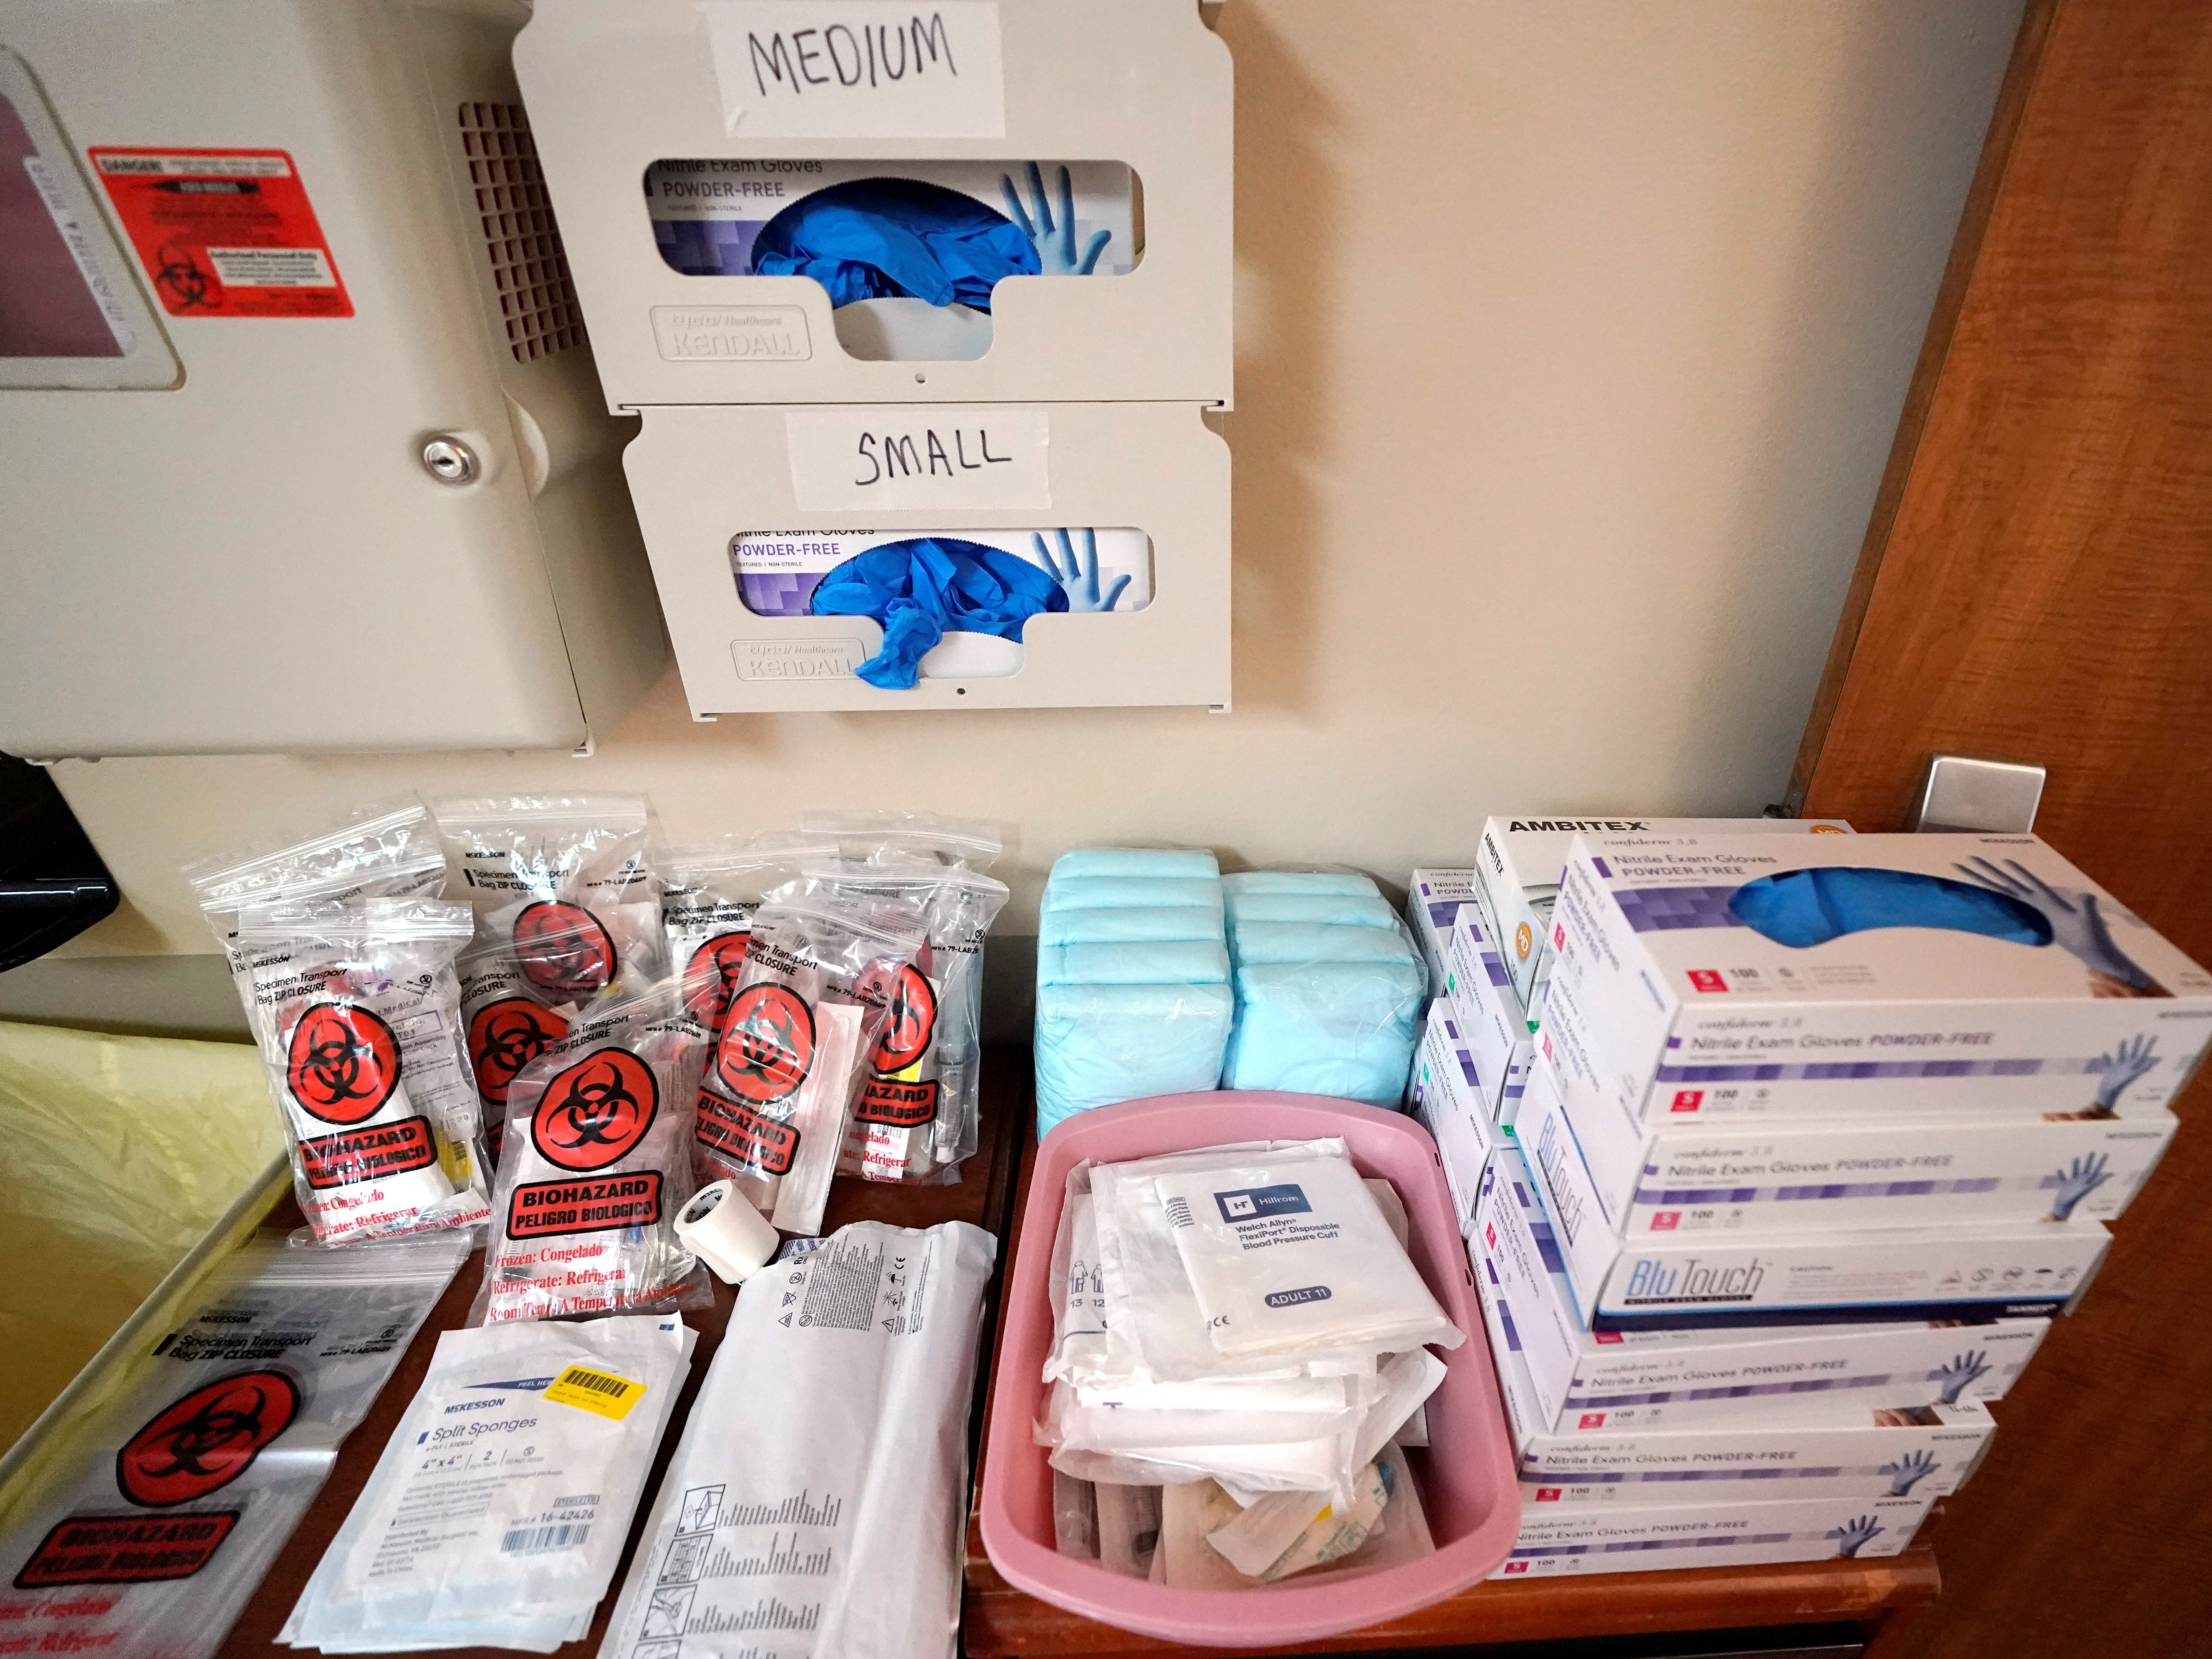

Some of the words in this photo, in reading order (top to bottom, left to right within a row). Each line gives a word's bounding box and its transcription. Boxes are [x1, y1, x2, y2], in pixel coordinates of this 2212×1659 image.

[749, 13, 957, 97] MEDIUM
[662, 182, 785, 197] POWDER-FREE
[856, 429, 1013, 486] SMALL
[732, 543, 841, 556] POWDER-FREE
[1614, 855, 1663, 864] Nitrile
[1667, 855, 1712, 864] Exam
[1716, 854, 1777, 864] Gloves
[473, 869, 518, 879] Specimen
[1622, 866, 1746, 877] POWDER-FREE
[478, 879, 496, 890] Bag
[496, 881, 509, 889] ZIP
[713, 902, 760, 912] Transport
[669, 916, 687, 927] Bag
[707, 912, 745, 923] CLOSURE
[1518, 929, 1529, 952] MD
[754, 952, 798, 976] CLOSURE
[772, 943, 818, 970] Transport
[255, 976, 297, 992] Specimen
[300, 968, 348, 983] Transport
[1453, 948, 1475, 1007] POWDER-FREE
[1456, 936, 1465, 963] Nitrile
[1465, 958, 1473, 982] Exam
[1472, 981, 1484, 1015] Gloves
[257, 995, 273, 1005] Bag
[274, 991, 287, 1001] ZIP
[288, 981, 327, 998] CLOSURE
[842, 988, 886, 1009] 79-LAB20609
[581, 1015, 629, 1032] Transport
[554, 1043, 569, 1055] ZIP
[570, 1028, 612, 1049] CLOSURE
[1691, 1036, 1742, 1050] Nitrile
[1745, 1035, 1794, 1049] Exam
[1800, 1034, 1862, 1049] Gloves
[1869, 1032, 1995, 1047] POWDER-FREE
[1426, 1040, 1449, 1101] POWDER-FREE
[1429, 1028, 1438, 1054] Nitrile
[1437, 1052, 1447, 1078] Exam
[1445, 1077, 1459, 1112] Gloves
[699, 1095, 787, 1146] BIOHAZARD
[870, 1104, 931, 1119] BIOLOGICO
[302, 1126, 417, 1163] BIOHAZARD
[863, 1150, 912, 1168] Refrigerar
[1721, 1163, 1766, 1177] Exam
[1770, 1161, 1830, 1175] Gloves
[1836, 1154, 1954, 1170] POWDER-FREE
[523, 1179, 649, 1208] BIOHAZARD
[1259, 1194, 1299, 1206] Hillrom
[356, 1206, 417, 1229] Refrigerar
[441, 1207, 491, 1227] Ambiente
[515, 1209, 577, 1230] PELIGRO
[581, 1200, 652, 1222] BIOLOGICO
[1235, 1222, 1267, 1233] Welch
[1289, 1222, 1340, 1234] Disposable
[1242, 1239, 1272, 1250] Blood
[1273, 1233, 1316, 1245] Pressure
[1316, 1230, 1339, 1239] Cuff
[1494, 1198, 1526, 1281] POWDER-FREE
[1496, 1186, 1510, 1220] Nitrile
[1509, 1219, 1523, 1254] Exam
[1522, 1252, 1539, 1299] Gloves
[494, 1253, 536, 1268] Frozen:
[540, 1243, 603, 1264] Congelado
[493, 1275, 562, 1295] Refrigerate:
[566, 1267, 628, 1287] Refrigerar
[1070, 1298, 1083, 1308] 13
[1092, 1298, 1105, 1308] 12
[1270, 1290, 1311, 1306] ADULT
[1316, 1288, 1327, 1298] 11
[490, 1305, 521, 1322] Room
[561, 1299, 570, 1313] A
[179, 1334, 253, 1348] Specimen
[250, 1336, 311, 1347] Transport
[168, 1348, 200, 1361] Bag
[200, 1349, 225, 1360] ZIP
[223, 1348, 285, 1360] CLOSURE
[1591, 1377, 1634, 1388] Nitrile
[1639, 1374, 1679, 1385] Exam
[1682, 1369, 1737, 1382] Gloves
[1742, 1359, 1849, 1376] POWDER-FREE
[432, 1423, 466, 1442] Split
[468, 1417, 538, 1437] Sponges
[483, 1450, 492, 1461] 2
[1545, 1455, 1589, 1465] Nitrile
[1592, 1455, 1631, 1465] Exam
[1635, 1453, 1688, 1464] Gloves
[1692, 1450, 1798, 1462] POWDER-FREE
[541, 1509, 596, 1523] 16-42426
[1557, 1530, 1594, 1540] Exam
[1597, 1526, 1648, 1537] Gloves
[1651, 1520, 1750, 1534] POWDER-FREE
